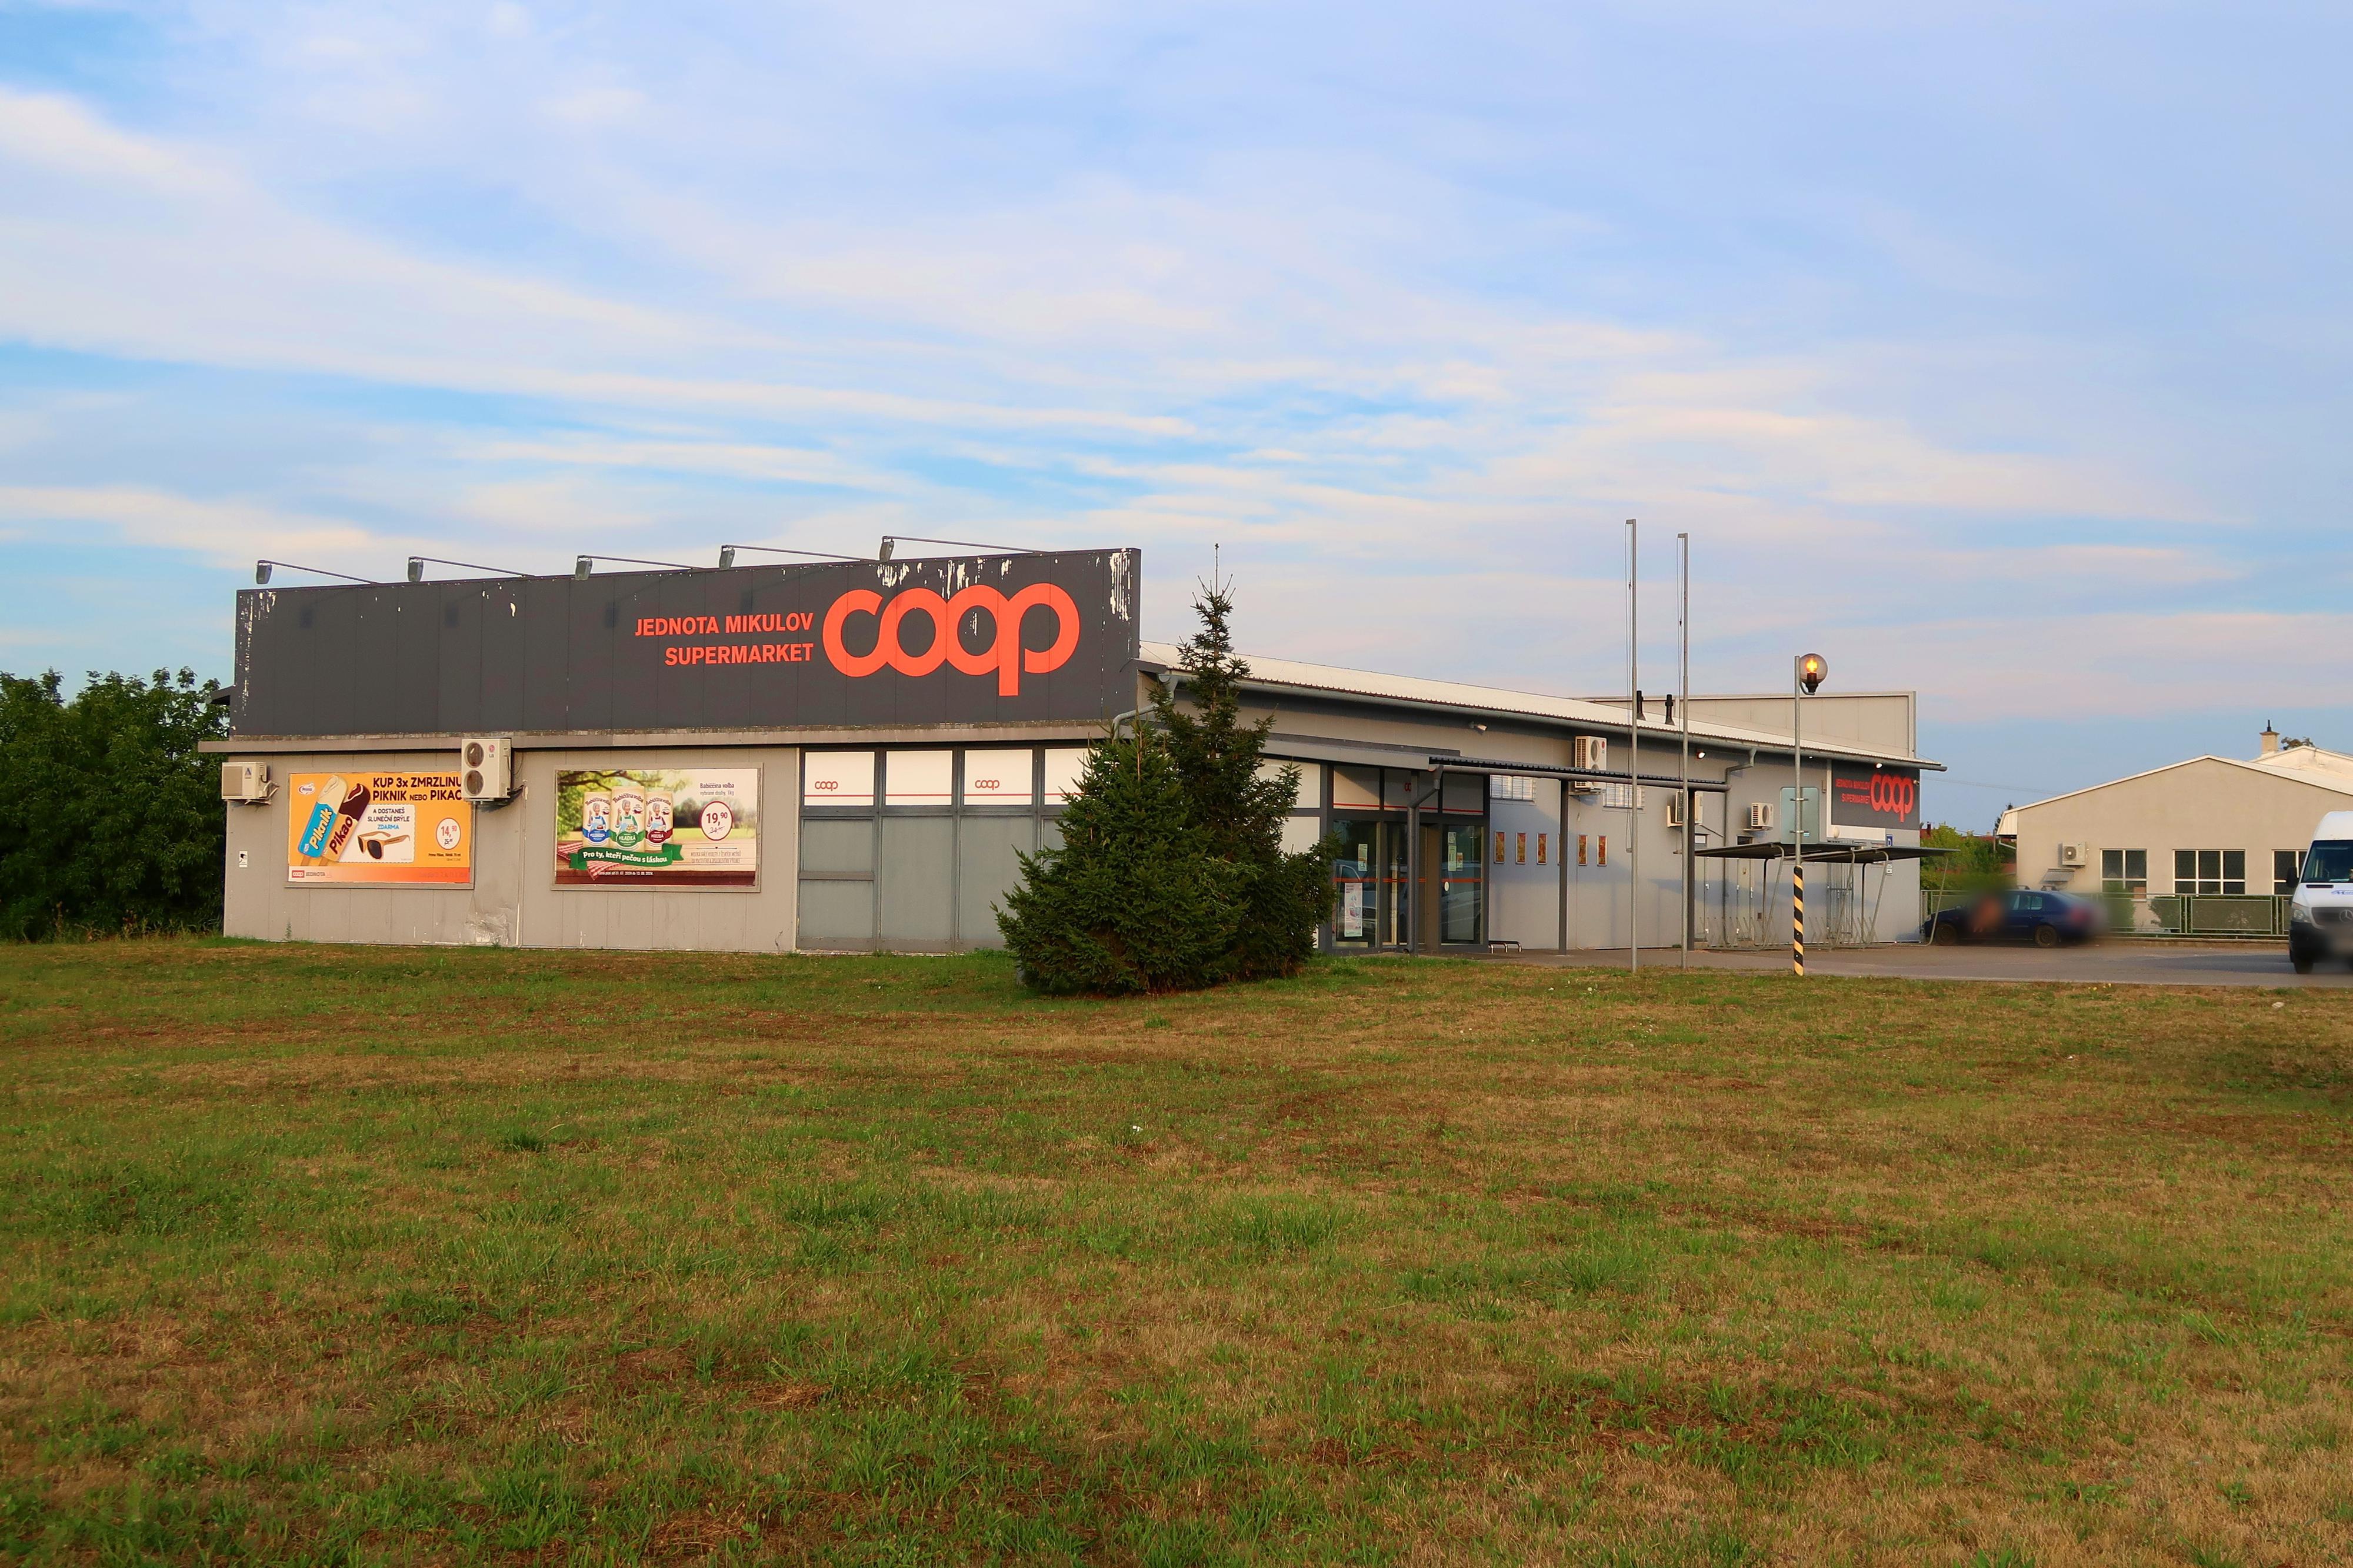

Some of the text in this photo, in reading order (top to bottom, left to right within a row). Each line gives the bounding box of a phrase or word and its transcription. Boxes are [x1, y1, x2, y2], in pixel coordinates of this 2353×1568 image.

[635, 612, 814, 636] JEDNOTA MIKULOV
[823, 583, 1079, 696] coop
[664, 643, 814, 666] SUPERMARKET
[373, 778, 394, 788] KUP
[396, 777, 408, 788] 3x
[815, 781, 838, 791] coop
[975, 780, 999, 790] coop
[372, 790, 407, 801] PIKNIK
[1841, 793, 1871, 804] SUPERMARKET
[1871, 773, 1914, 823] coop
[309, 808, 333, 850] Piknik
[329, 816, 353, 854] Pikao
[622, 854, 641, 862] pečou
